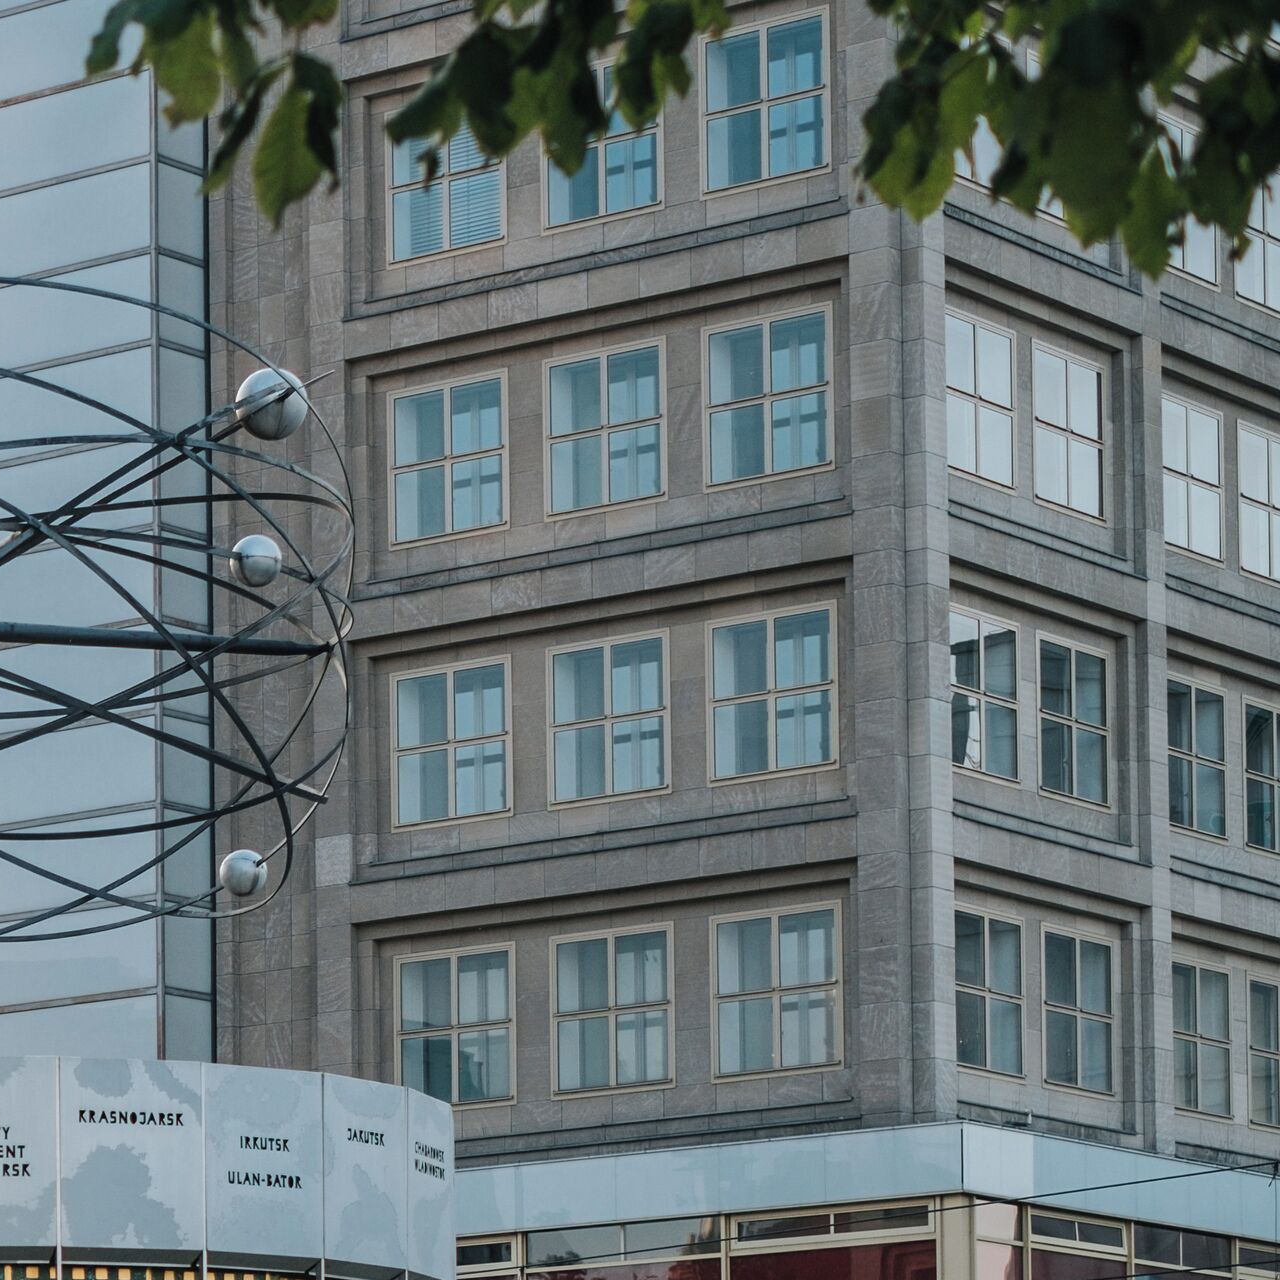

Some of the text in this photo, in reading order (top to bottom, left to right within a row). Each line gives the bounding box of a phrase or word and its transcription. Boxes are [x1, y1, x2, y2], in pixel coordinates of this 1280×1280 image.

[79, 1109, 184, 1127] KRASNOJARSK
[239, 1136, 290, 1153] IRKUTSK
[347, 1128, 385, 1147] JAKUTSK
[228, 1171, 302, 1189] ULAN-BATOR
